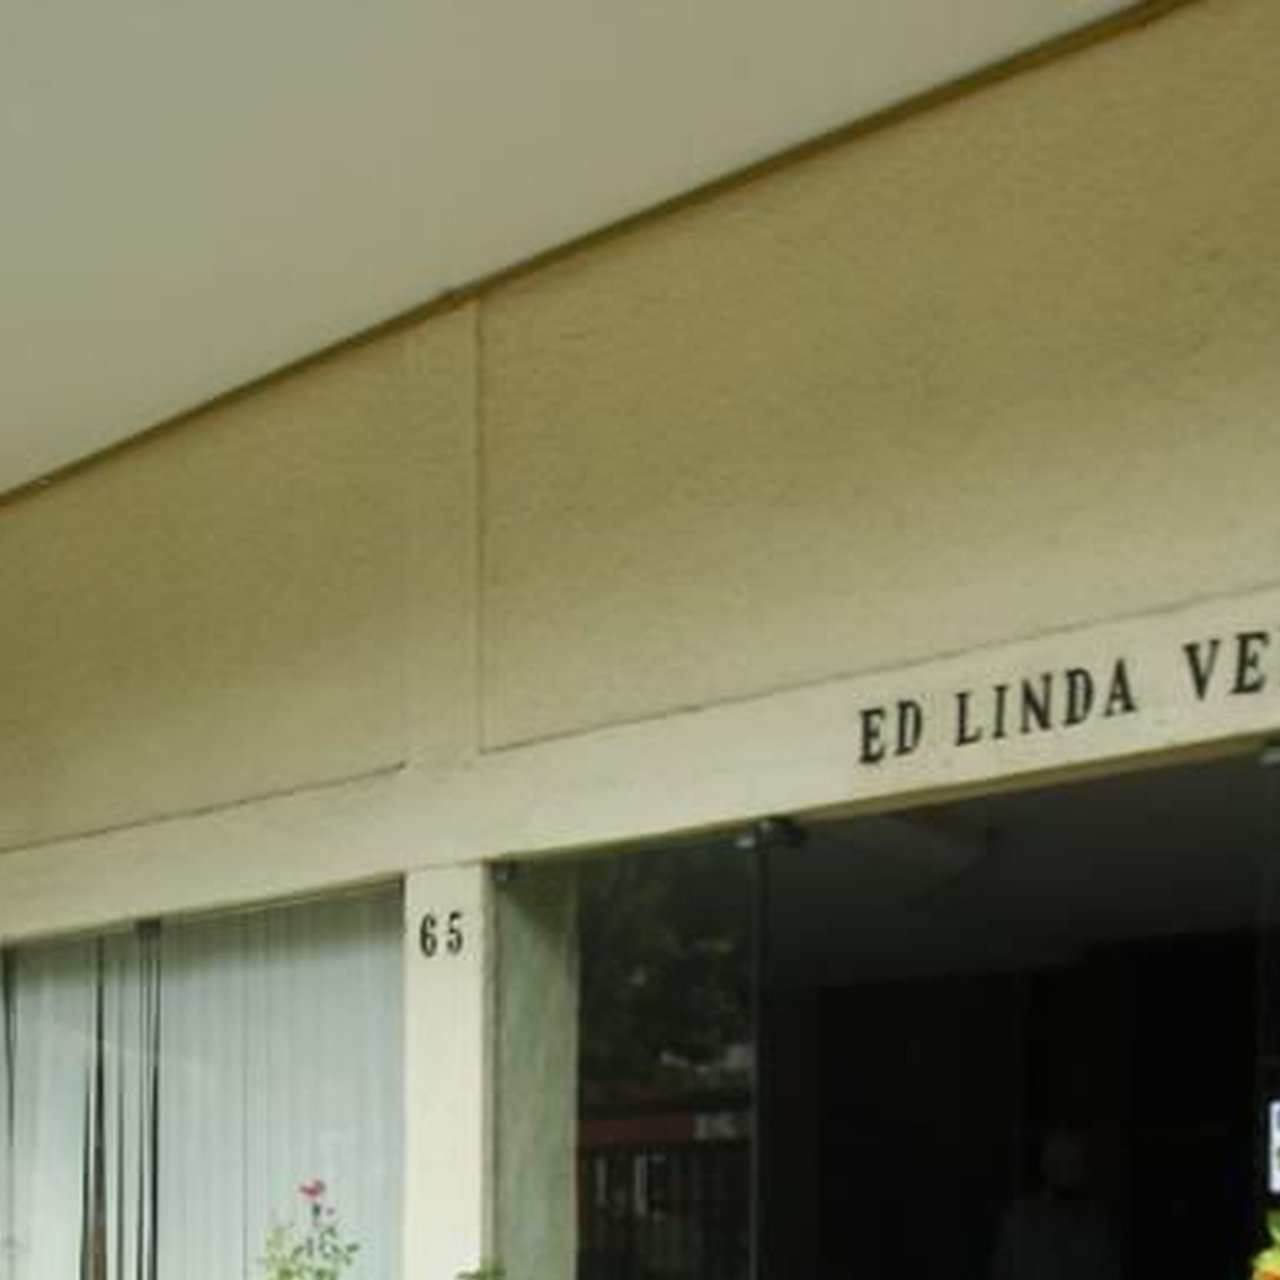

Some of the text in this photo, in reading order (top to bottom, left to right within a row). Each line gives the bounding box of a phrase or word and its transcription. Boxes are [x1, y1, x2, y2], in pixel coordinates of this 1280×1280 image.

[858, 698, 923, 764] ED
[954, 657, 1137, 746] LINDA
[420, 912, 463, 957] 65
